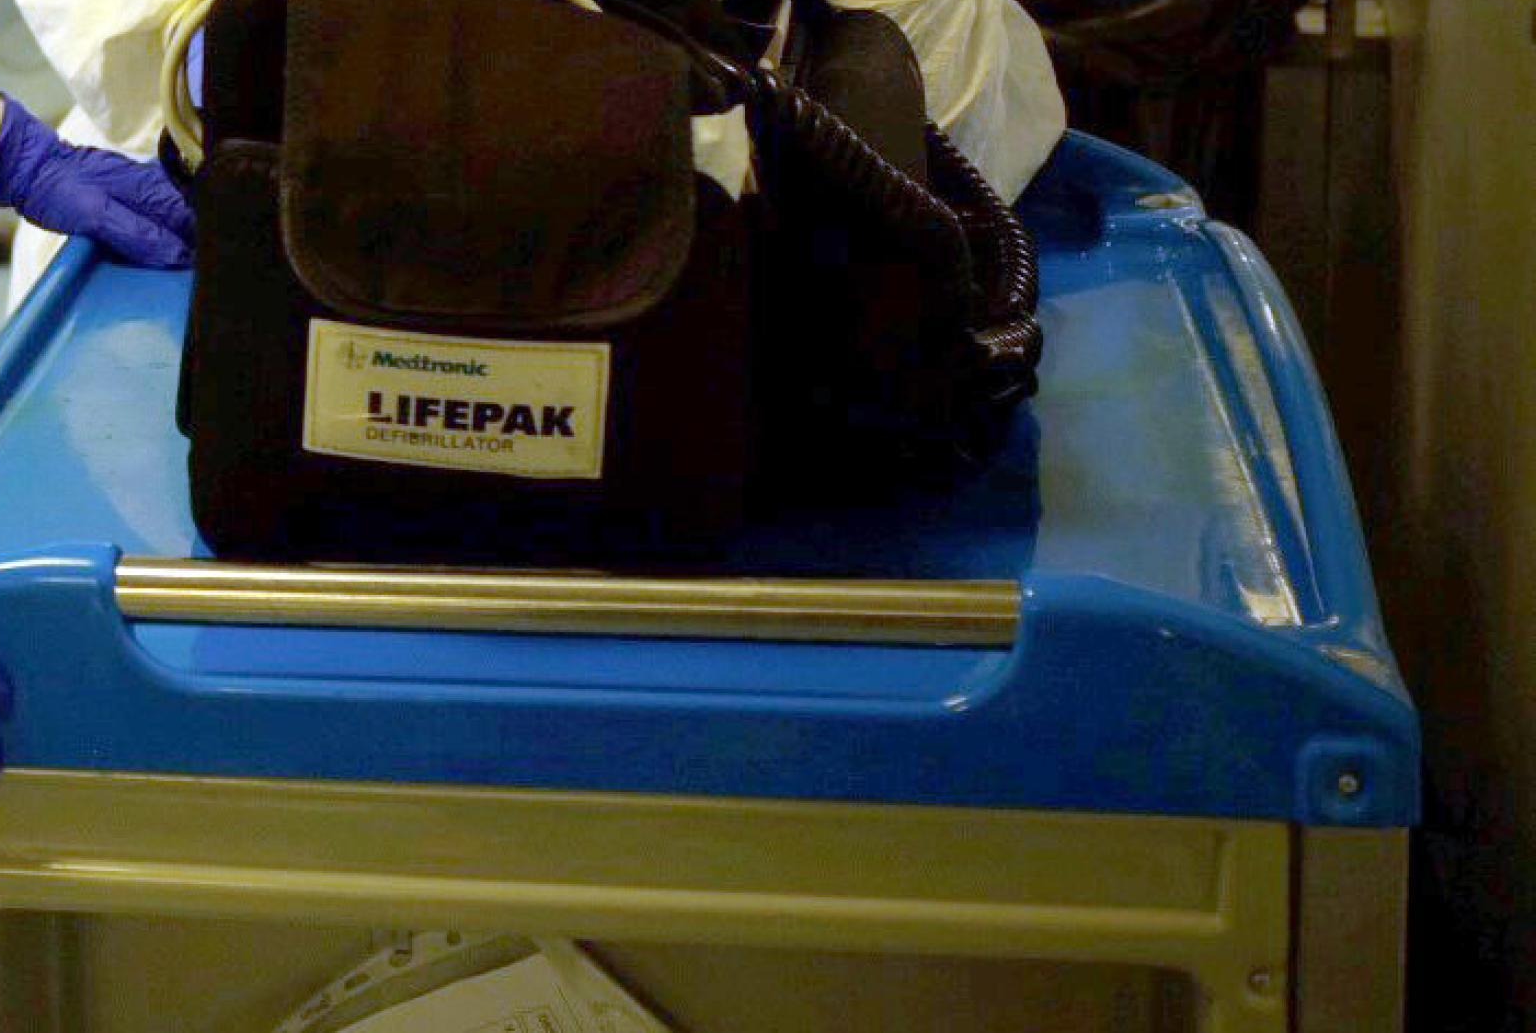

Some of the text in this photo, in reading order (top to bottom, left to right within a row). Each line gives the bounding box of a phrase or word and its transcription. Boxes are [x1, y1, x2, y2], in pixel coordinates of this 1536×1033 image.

[372, 350, 488, 377] Medtronic
[367, 391, 576, 438] LIFEPAK
[365, 426, 514, 454] DEFIBRILLATOR
